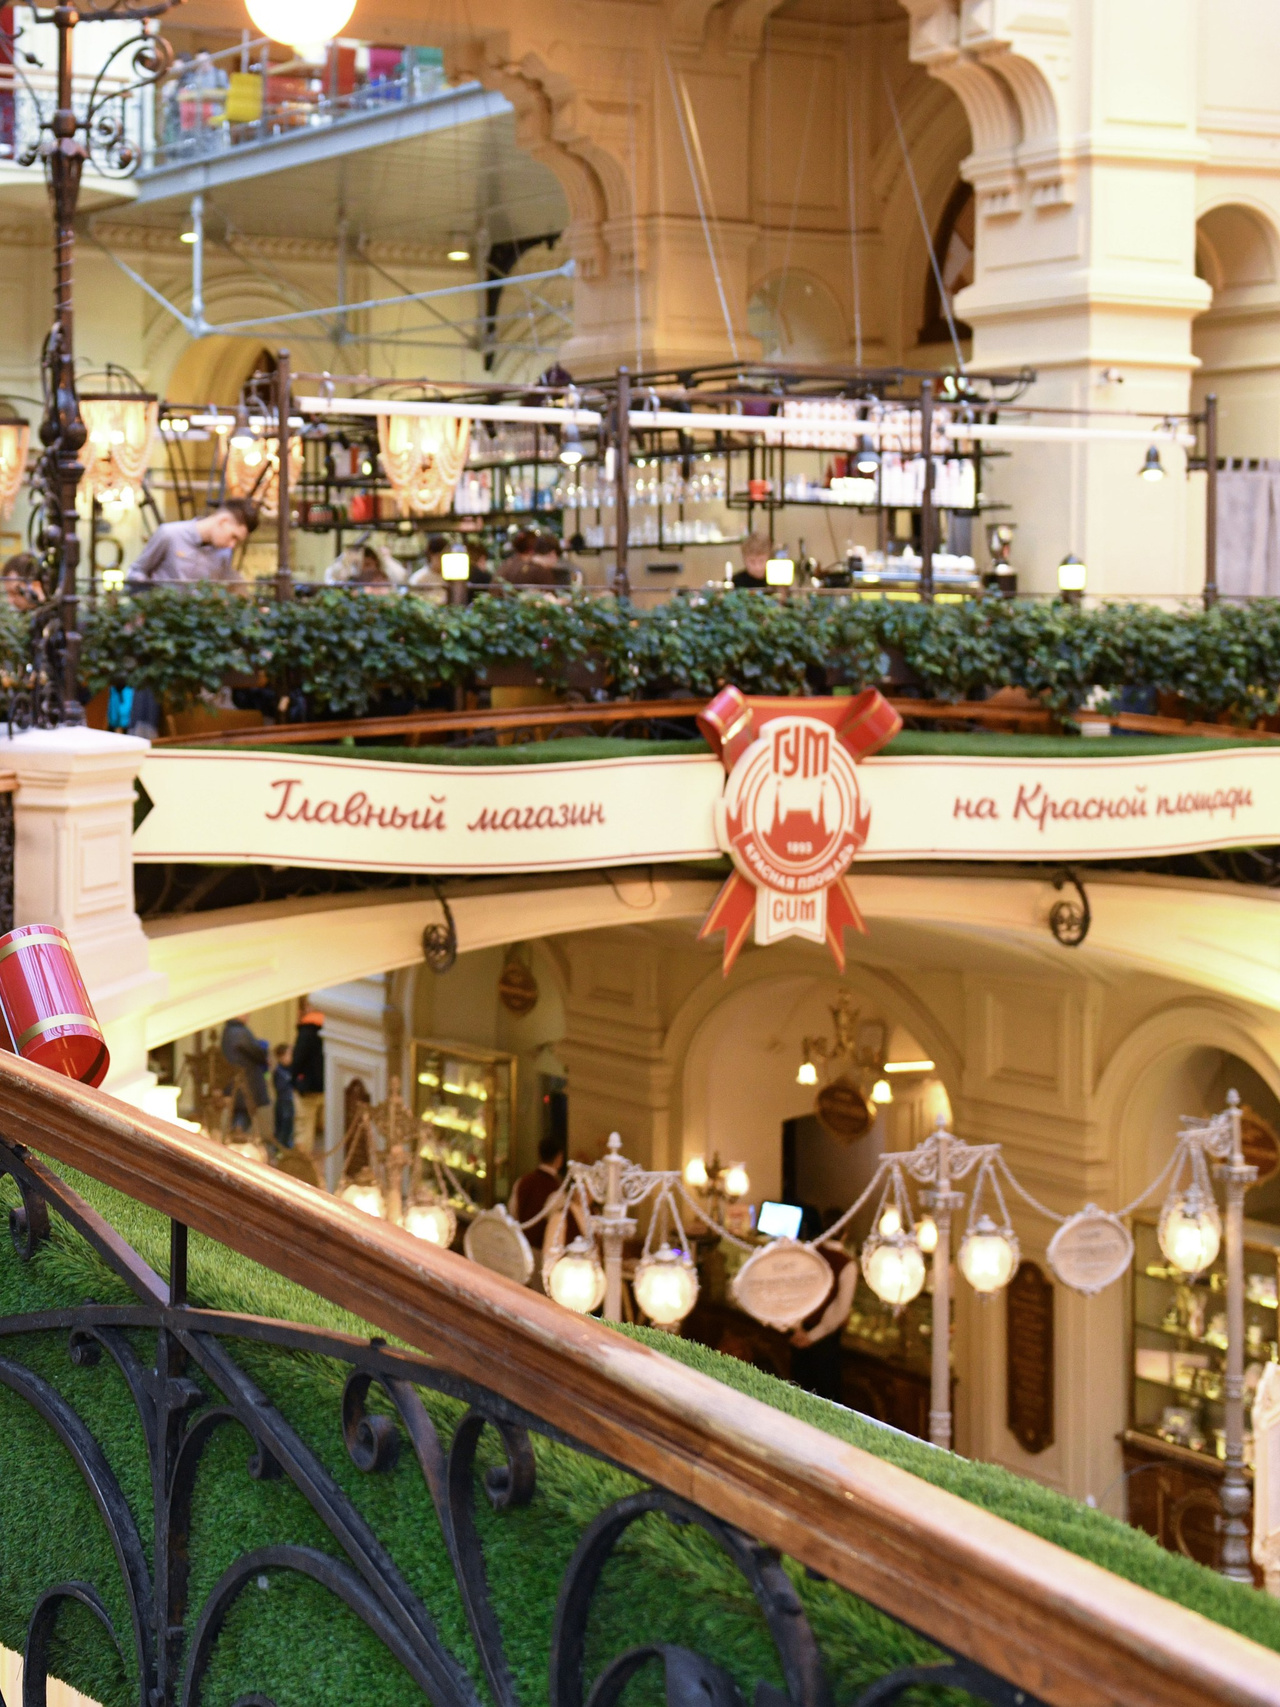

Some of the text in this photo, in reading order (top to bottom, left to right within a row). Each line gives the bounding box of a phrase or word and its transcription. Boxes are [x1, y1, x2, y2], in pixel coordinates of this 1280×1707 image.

[773, 724, 830, 779] ГУМ
[265, 778, 606, 831] Главный магазин
[952, 781, 1254, 832] на Красной площади
[744, 841, 855, 890] КРАСНАЯ ПЛОЩАДЬ
[772, 898, 816, 922] GUM
